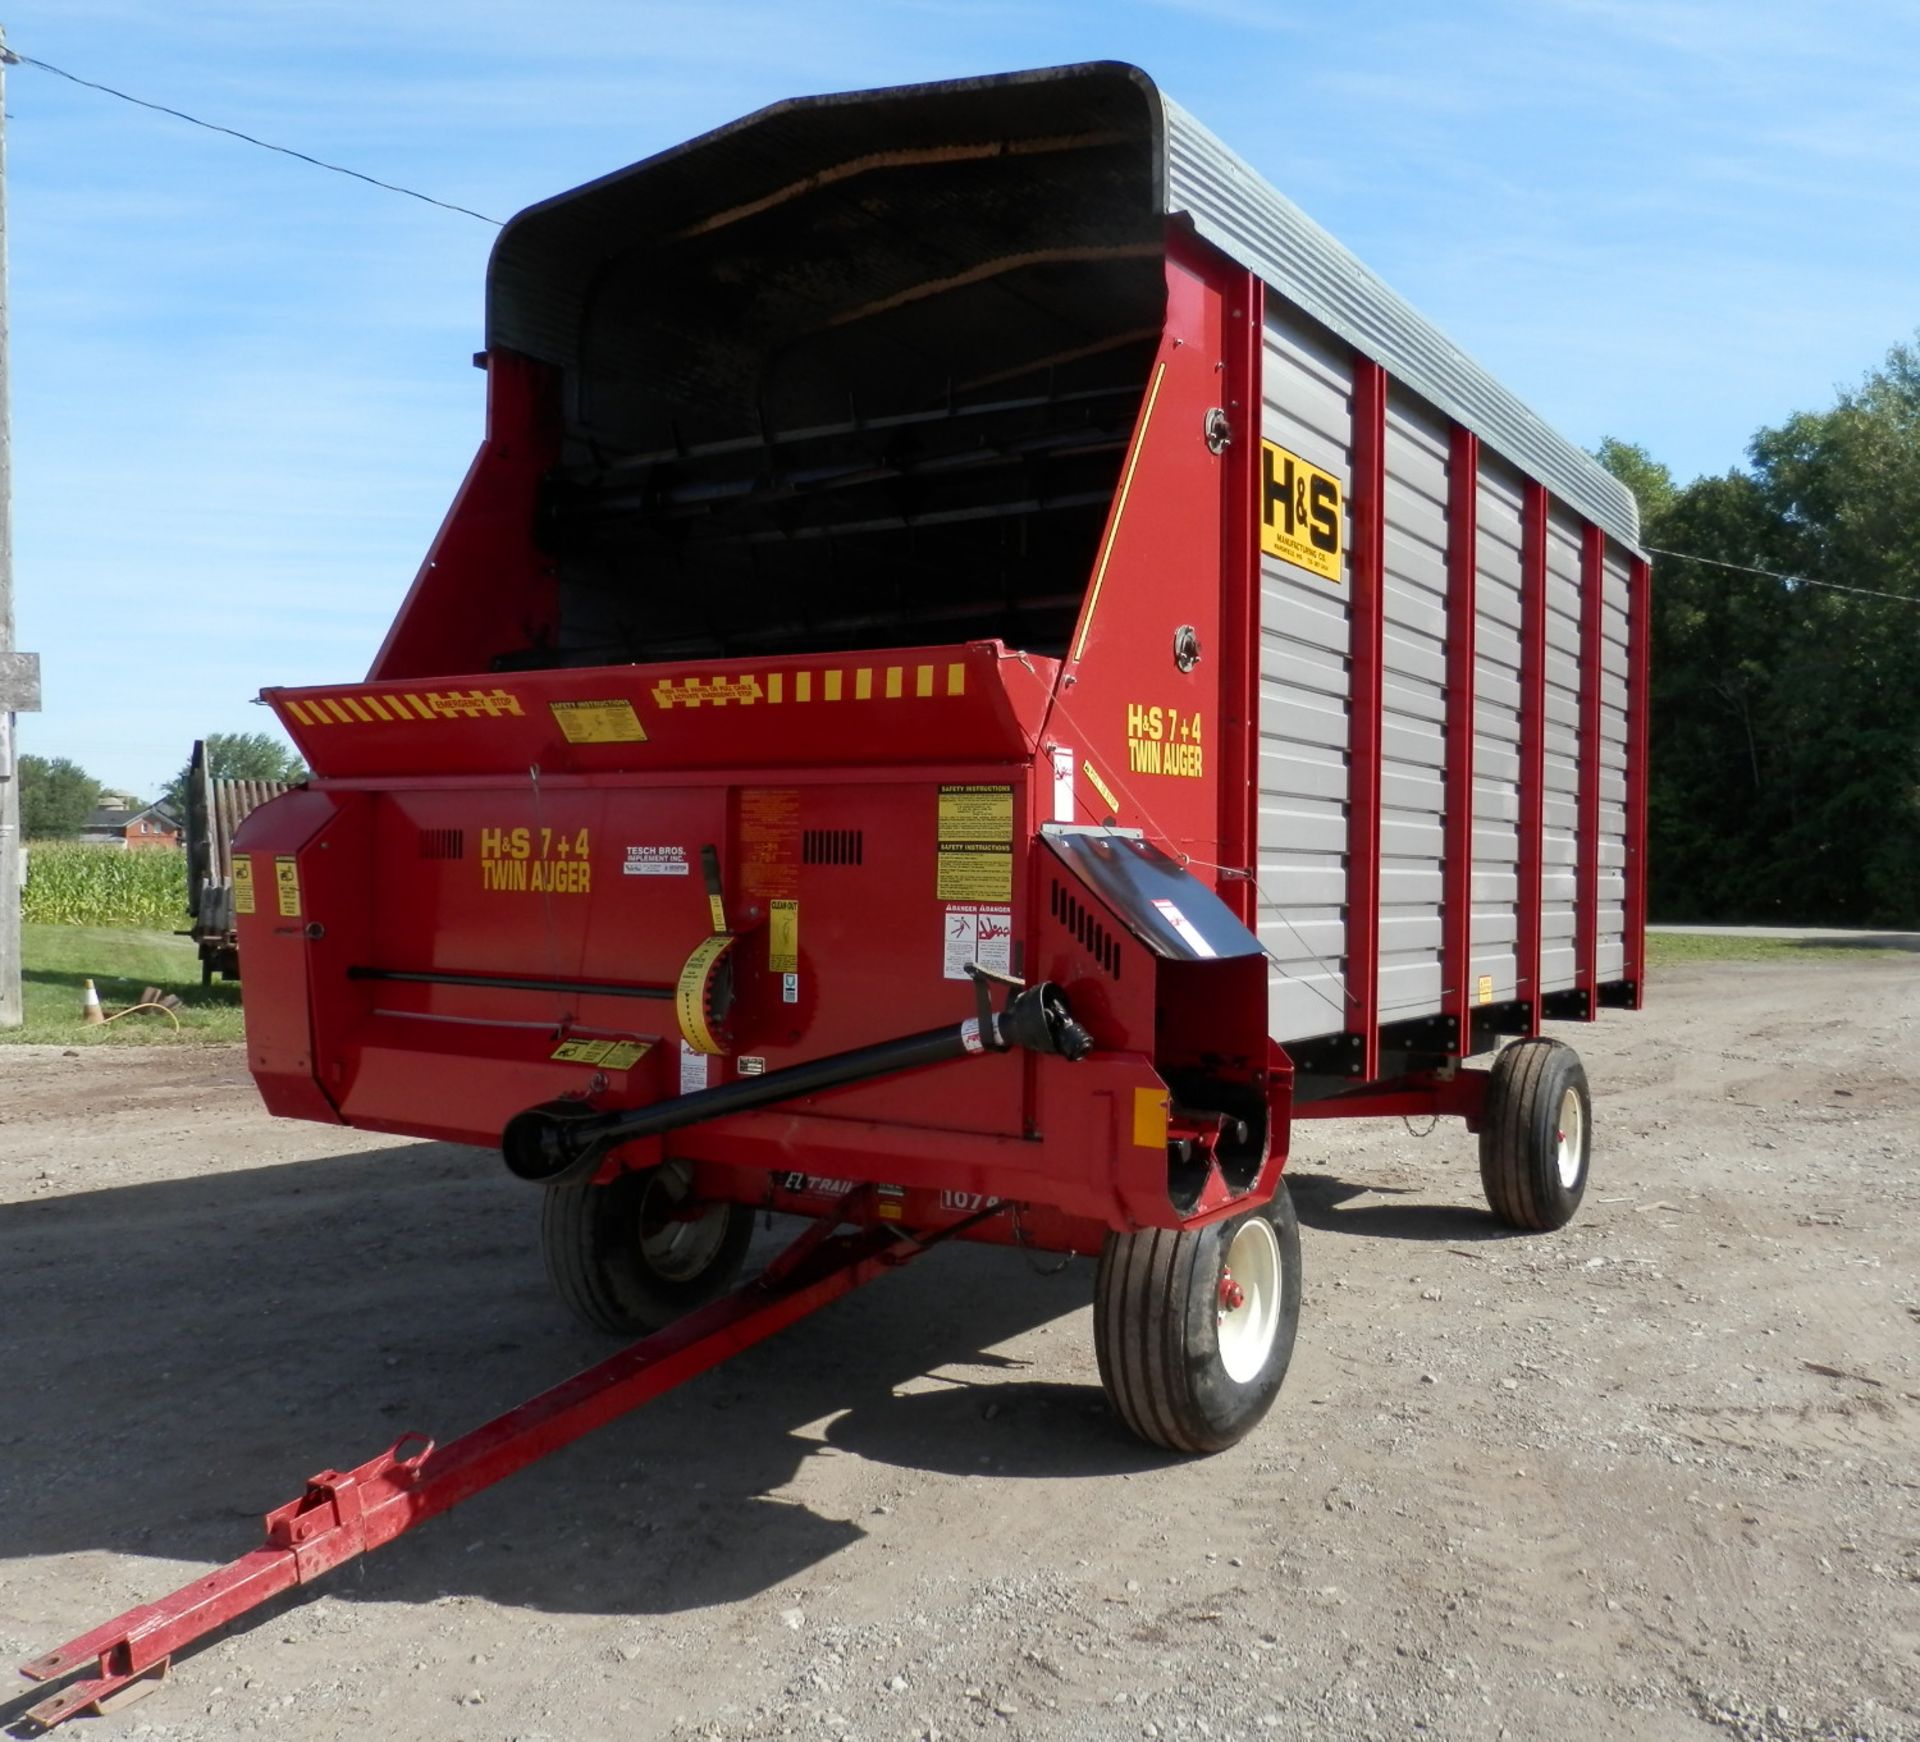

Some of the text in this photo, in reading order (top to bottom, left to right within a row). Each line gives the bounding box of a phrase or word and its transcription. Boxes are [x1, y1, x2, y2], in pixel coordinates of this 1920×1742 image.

[1263, 447, 1338, 555] H&S
[1276, 533, 1317, 559] MANUFACTURING
[435, 697, 511, 710] EMERGENCY STOP
[1128, 703, 1163, 740] H&S
[1128, 738, 1203, 777] TWIN AUGER
[481, 828, 530, 859] H&S
[626, 846, 687, 856] TESCH BROS.
[482, 860, 591, 893] TWIN AUGER
[787, 901, 797, 910] OUT
[985, 905, 1011, 913] DANGER
